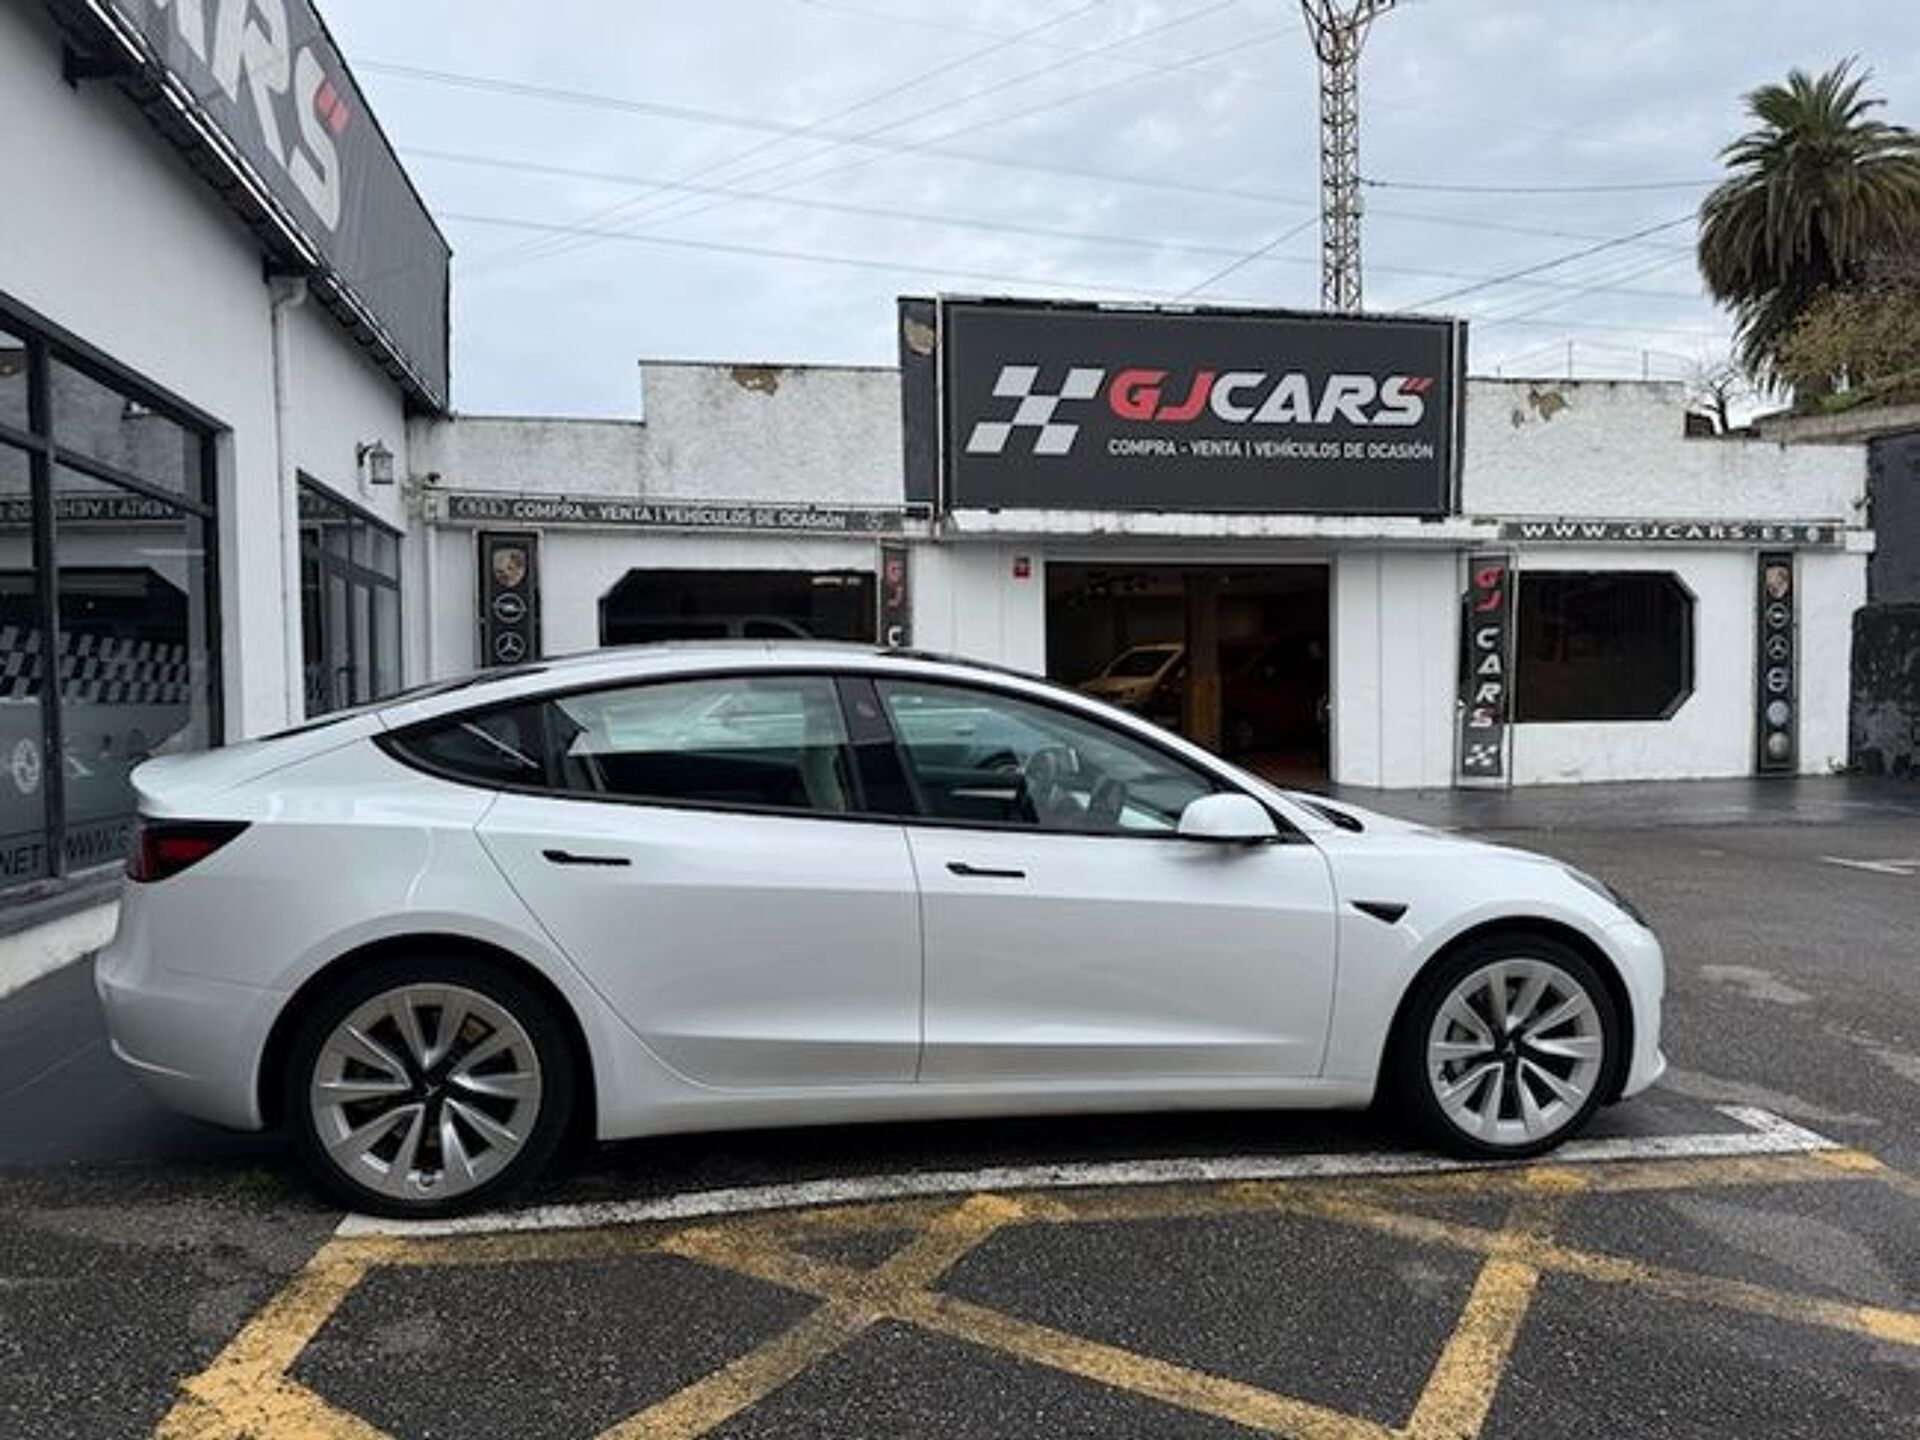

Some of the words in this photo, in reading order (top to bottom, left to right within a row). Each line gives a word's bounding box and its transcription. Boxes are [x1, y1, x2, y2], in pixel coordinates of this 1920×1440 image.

[1109, 369, 1433, 425] GJCARS
[1108, 438, 1177, 456] COMPRA
[1190, 440, 1241, 458] VENTA
[1343, 441, 1364, 458] DE
[1367, 440, 1434, 459] OCASIÓN
[512, 500, 586, 520] COMPRA
[599, 503, 656, 521] VENTA
[755, 508, 776, 527] DE
[1520, 522, 1795, 541] WWW.GJCARS.ES
[1469, 627, 1503, 728] CARS
